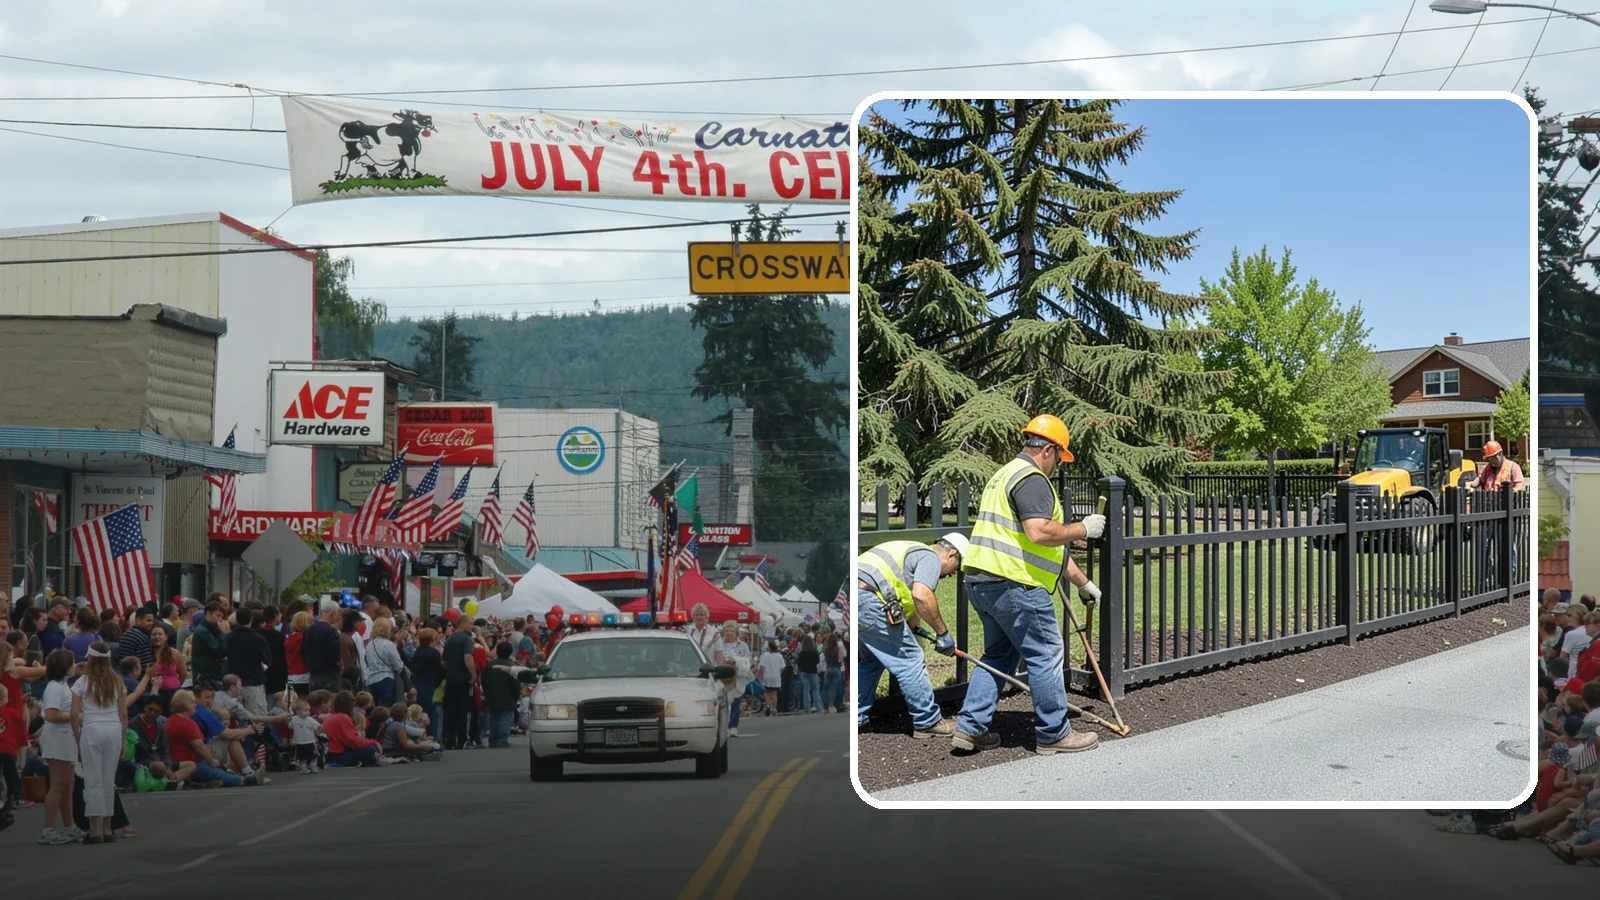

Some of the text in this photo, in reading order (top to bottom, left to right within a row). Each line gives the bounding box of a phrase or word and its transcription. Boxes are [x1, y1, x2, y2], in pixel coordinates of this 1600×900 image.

[481, 141, 605, 193] JULY
[632, 150, 747, 198] 4th.
[696, 254, 850, 281] CROSSWA
[283, 380, 373, 420] ACE
[406, 408, 485, 422] CEDAR LOG
[283, 421, 371, 436] Hardware
[95, 485, 124, 495] Vincent
[126, 486, 136, 495] de
[137, 486, 155, 495] Paul
[688, 526, 741, 536] CRNATION
[699, 535, 730, 544] GLASS
